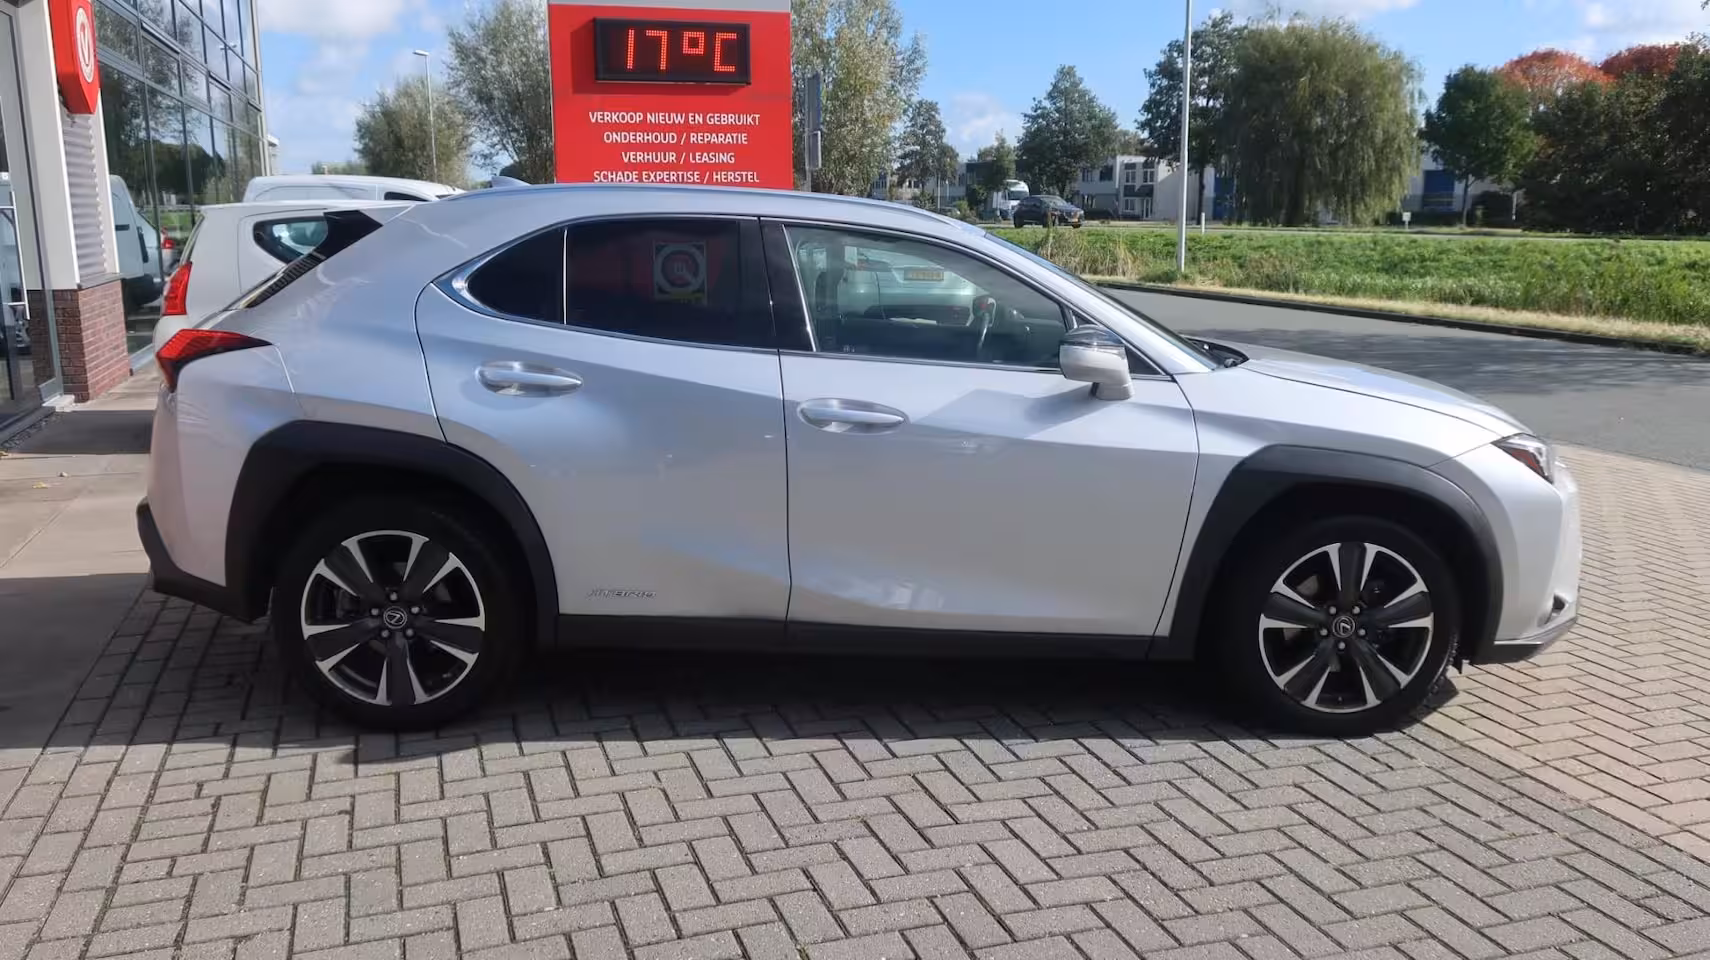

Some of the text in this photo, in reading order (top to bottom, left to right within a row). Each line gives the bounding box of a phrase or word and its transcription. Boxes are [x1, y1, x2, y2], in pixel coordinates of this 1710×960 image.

[589, 111, 760, 125] VERKOOP NIEUW EN GEBRUIKT
[603, 131, 677, 144] ONDERHOUD
[690, 133, 748, 144] REPARATIE
[621, 151, 677, 163] VERHUUR
[689, 152, 735, 164] LEASING
[593, 170, 639, 182] SCHADE
[642, 171, 700, 183] EXPERTISE
[712, 171, 760, 183] HERSTEL
